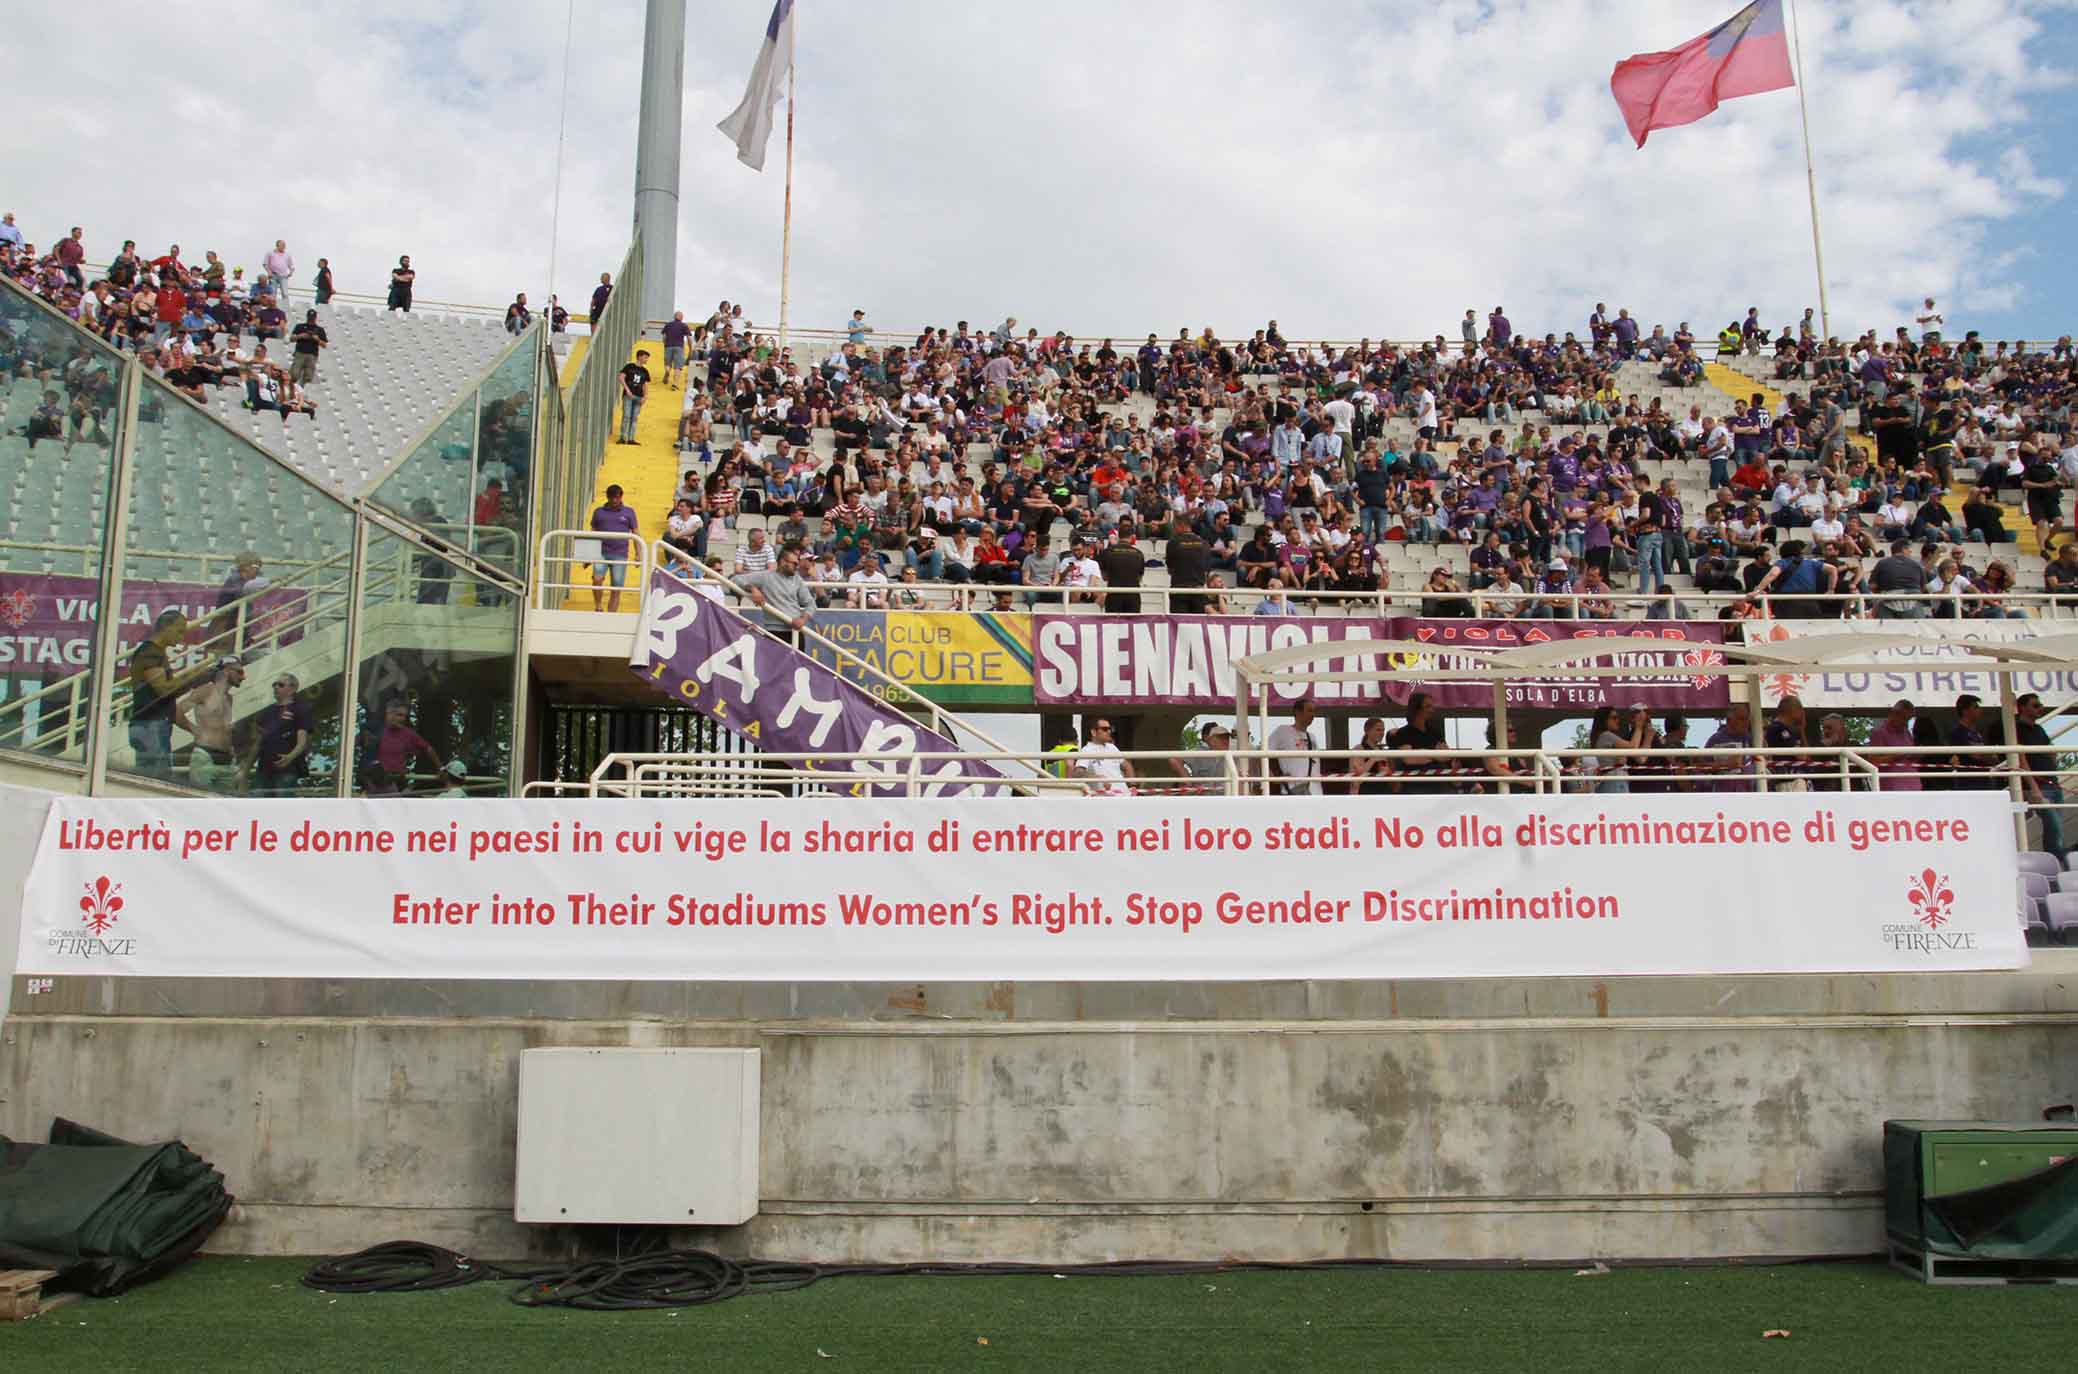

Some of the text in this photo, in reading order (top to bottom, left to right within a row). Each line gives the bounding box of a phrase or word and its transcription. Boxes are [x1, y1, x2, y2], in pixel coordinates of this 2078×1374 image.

[815, 624, 951, 644] VIOLA CLUB
[1417, 627, 1551, 642] VIOLA
[1040, 621, 1382, 698] SIENAVIOLA
[1552, 687, 1607, 703] D'ELBA
[59, 810, 1968, 862] Libertà per le donne nei paesi in cui vige la sharia di entrare nei loro stadi. No alla discriminazione di genere
[393, 886, 1619, 934] Enter into Their Stadiums Women's Right. Stop Gender Discrimination
[57, 937, 136, 959] FIRENZE
[1895, 932, 1977, 954] FIRENZE
